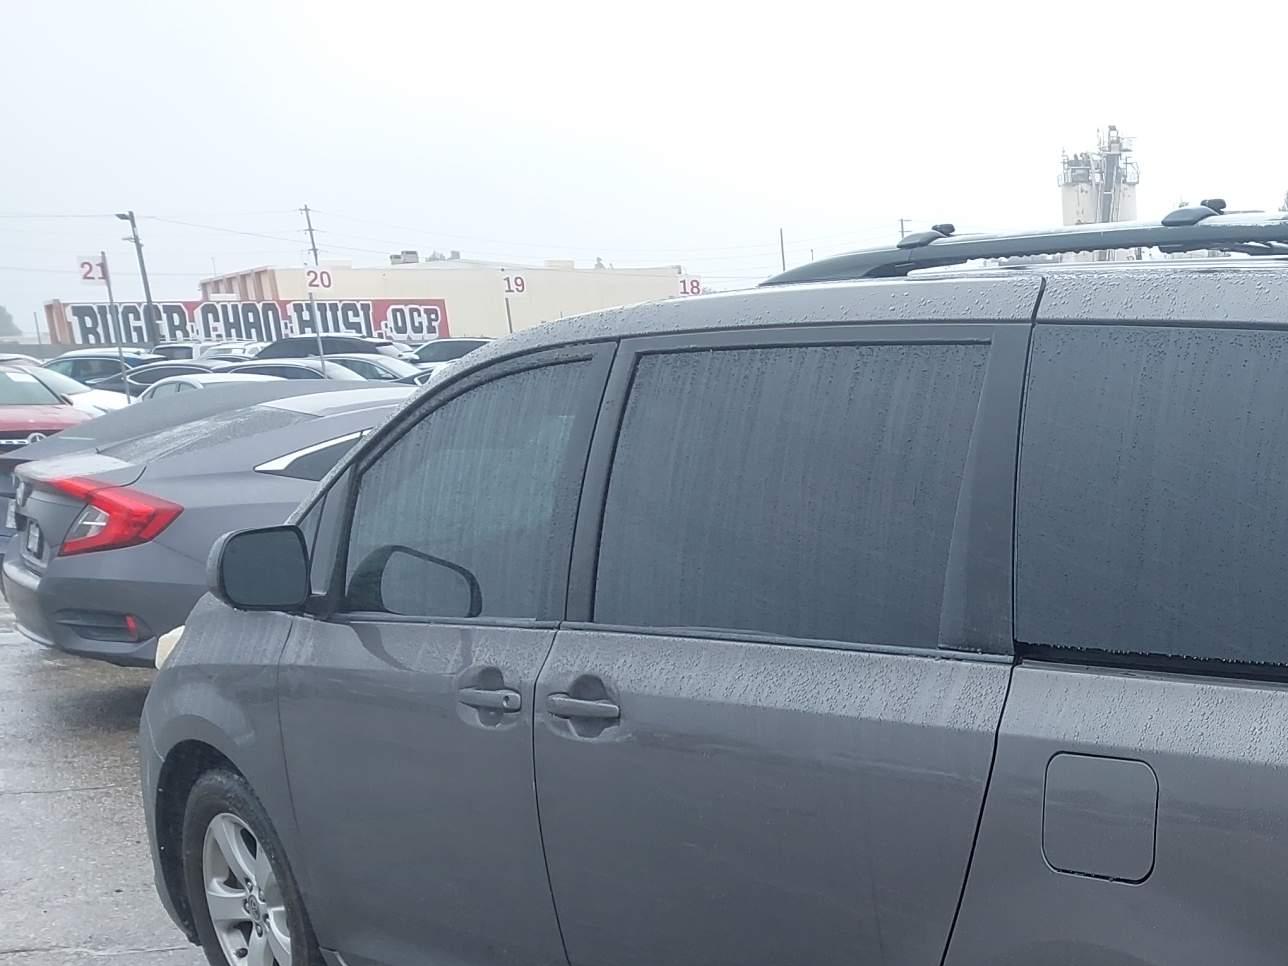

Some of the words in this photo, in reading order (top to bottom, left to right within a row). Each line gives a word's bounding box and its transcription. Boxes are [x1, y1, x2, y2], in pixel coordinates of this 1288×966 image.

[80, 261, 108, 280] 21
[307, 270, 332, 288] 20
[503, 276, 525, 293] 19
[679, 279, 701, 295] 18
[390, 306, 440, 335] OCP
